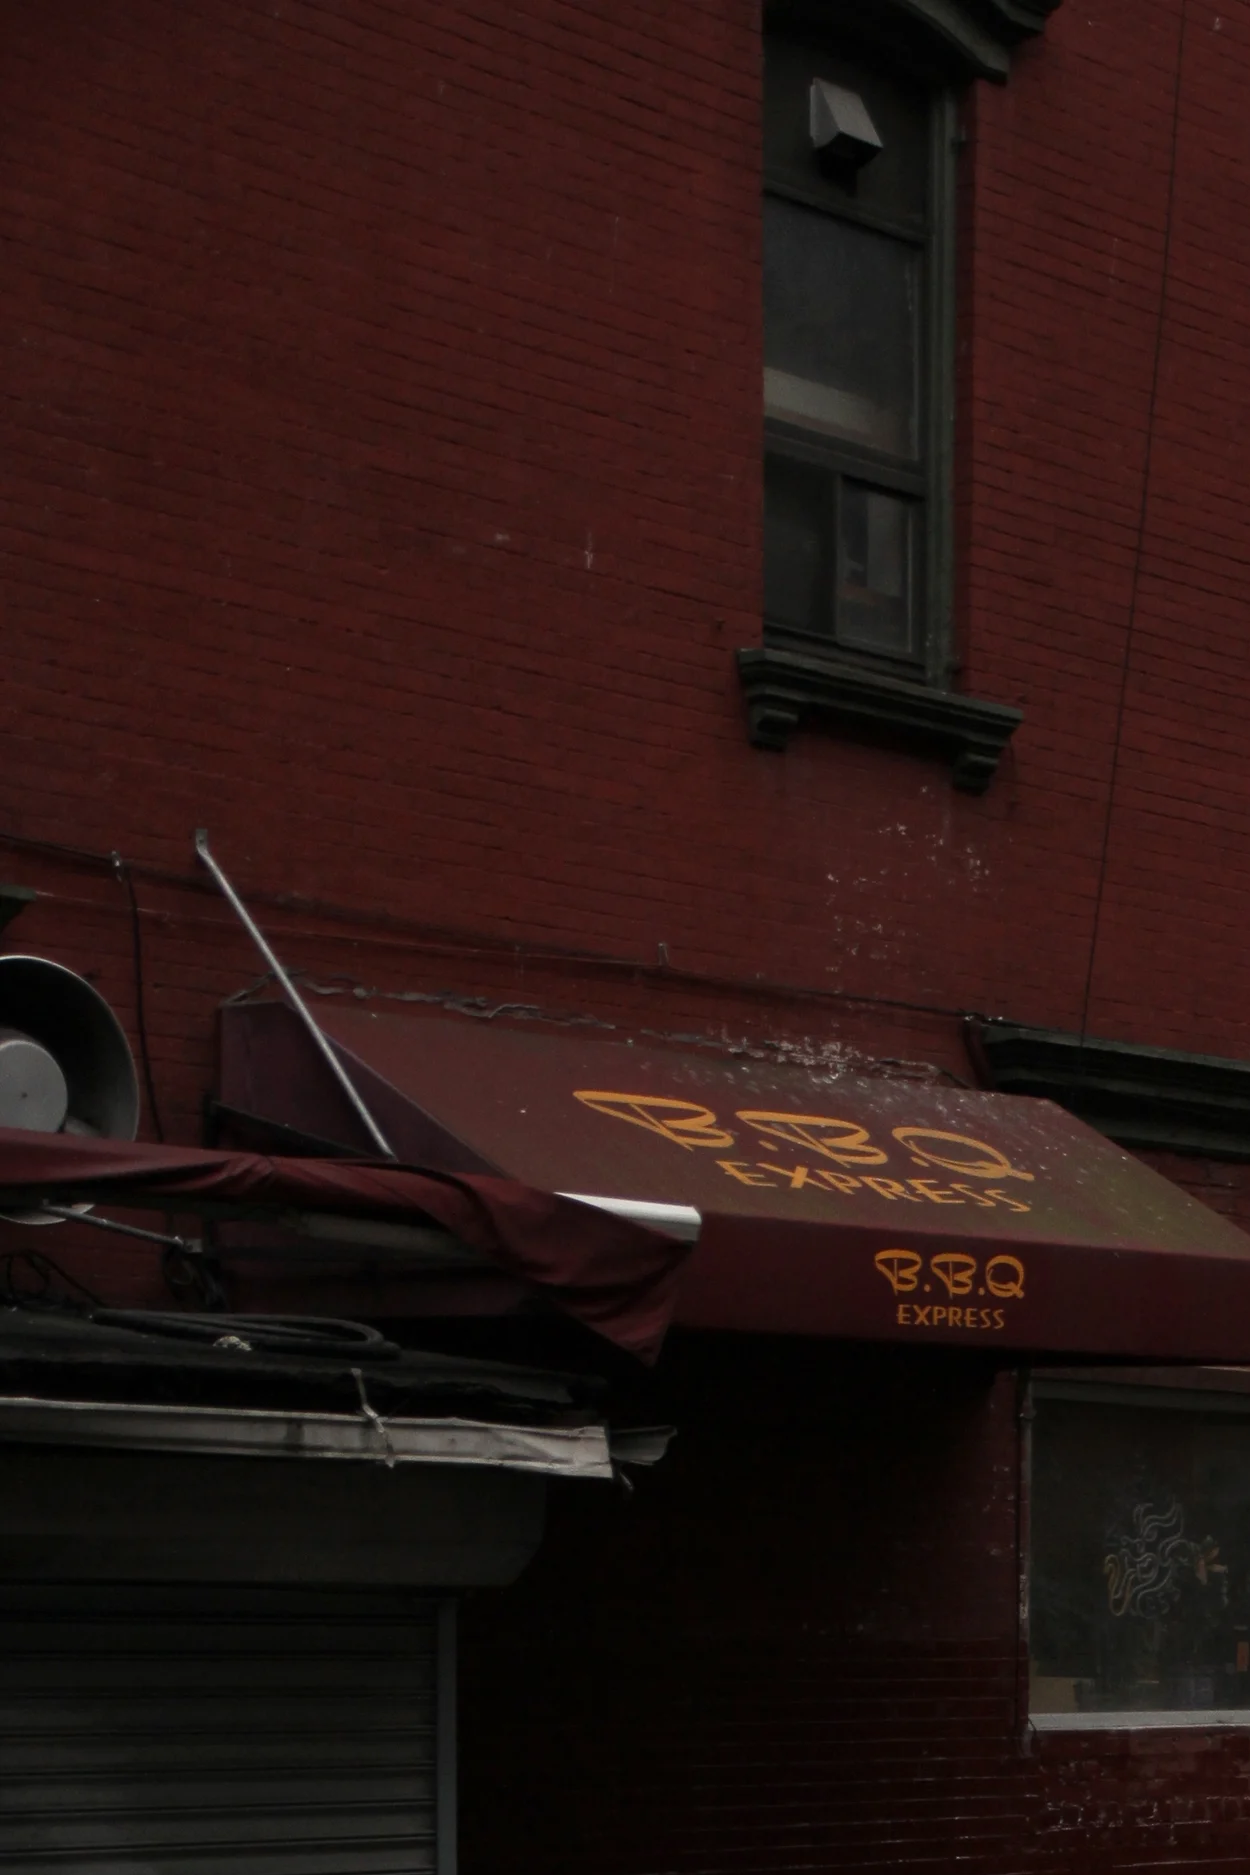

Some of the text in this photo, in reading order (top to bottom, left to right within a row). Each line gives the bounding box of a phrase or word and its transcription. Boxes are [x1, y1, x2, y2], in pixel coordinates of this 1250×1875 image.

[572, 1089, 1035, 1183] B.B.Q
[716, 1160, 1033, 1213] EXPRESS
[874, 1248, 1026, 1300] B.B.Q
[895, 1304, 1005, 1330] EXPRESS
